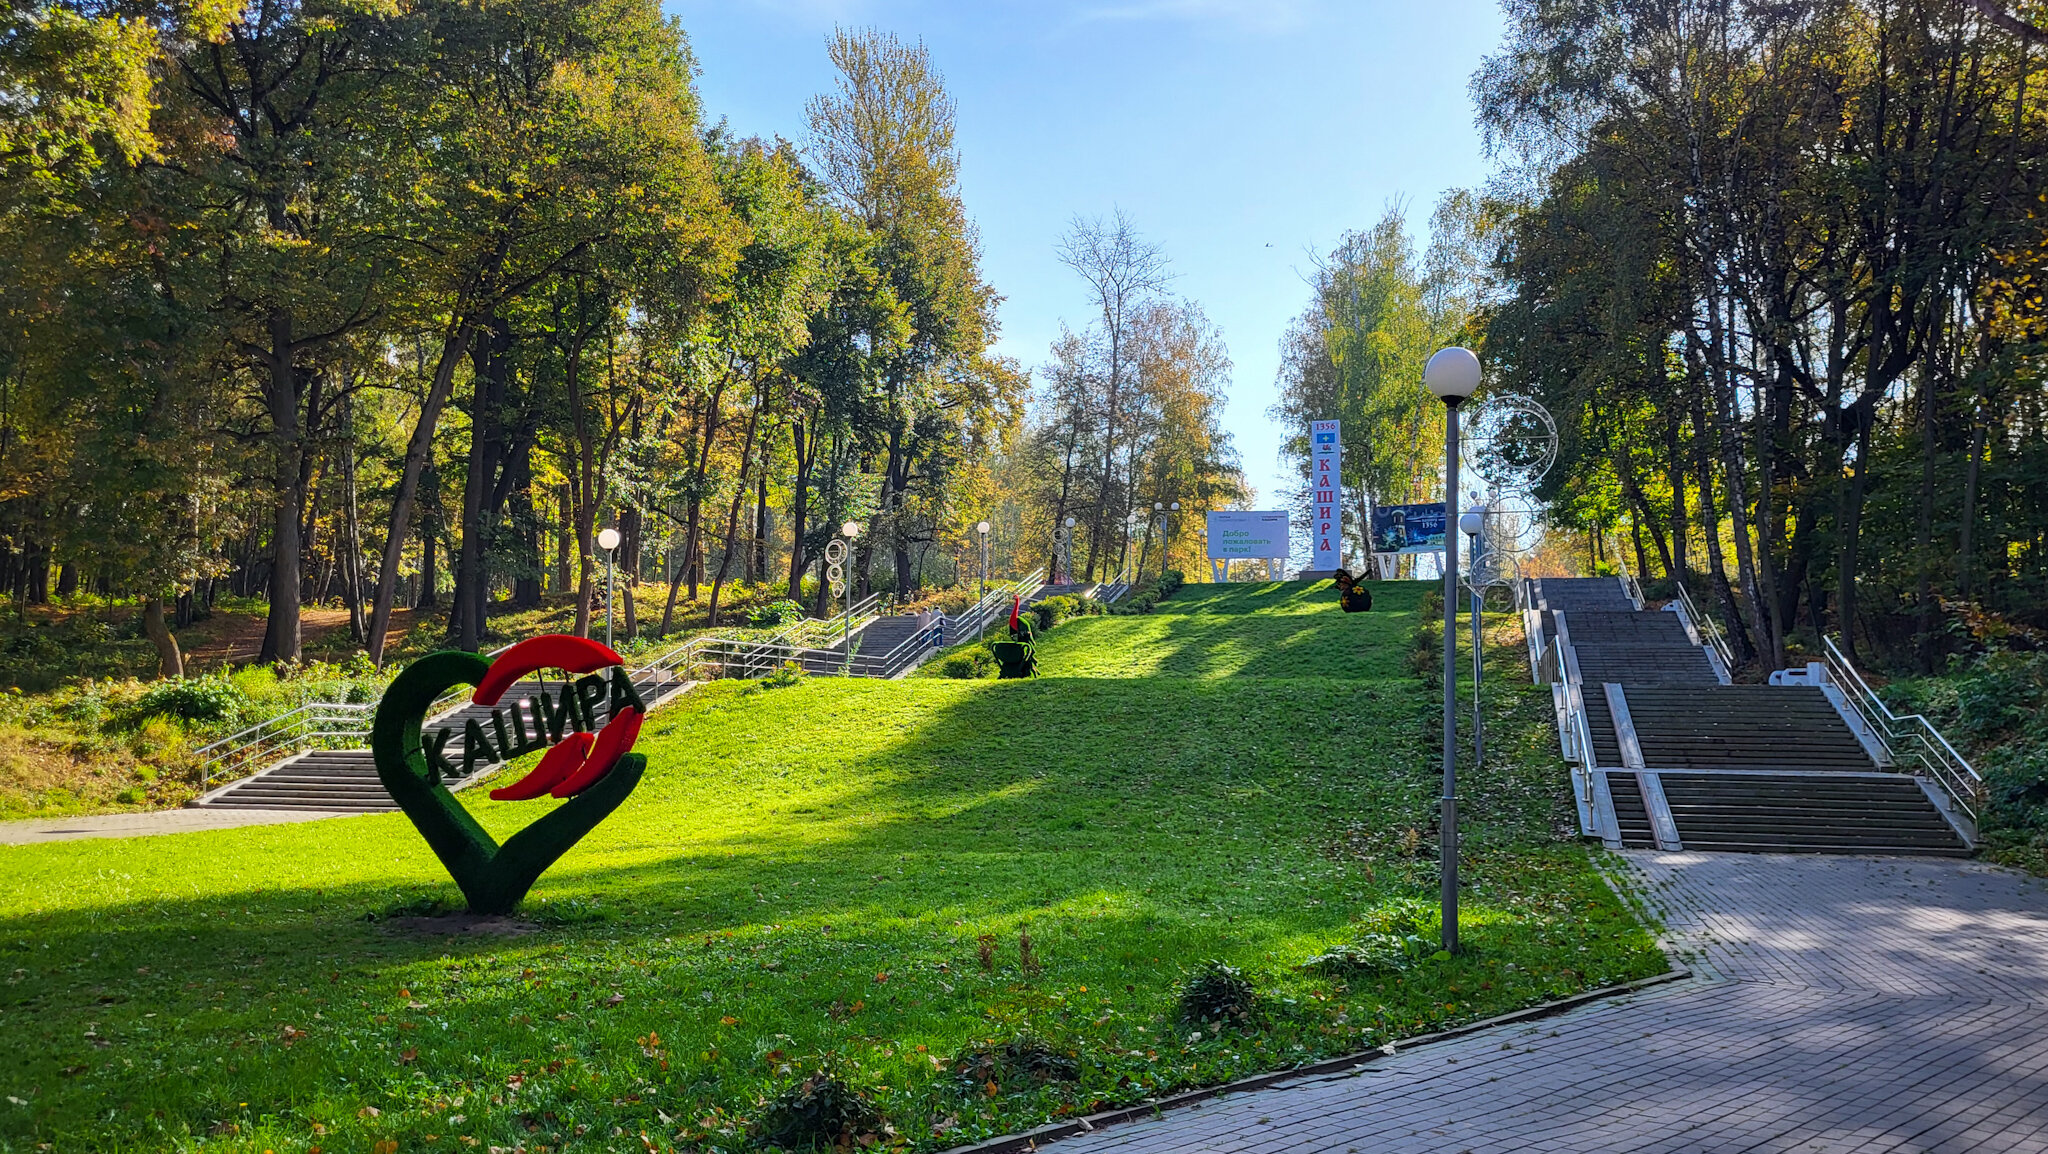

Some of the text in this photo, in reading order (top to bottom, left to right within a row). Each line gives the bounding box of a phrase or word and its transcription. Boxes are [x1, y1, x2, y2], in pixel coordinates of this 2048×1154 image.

[1316, 422, 1336, 431] 1356
[1316, 458, 1334, 551] КАШИРА
[1222, 530, 1250, 538] Добро
[1229, 546, 1252, 554] парк!
[421, 666, 646, 786] КАШИРА
